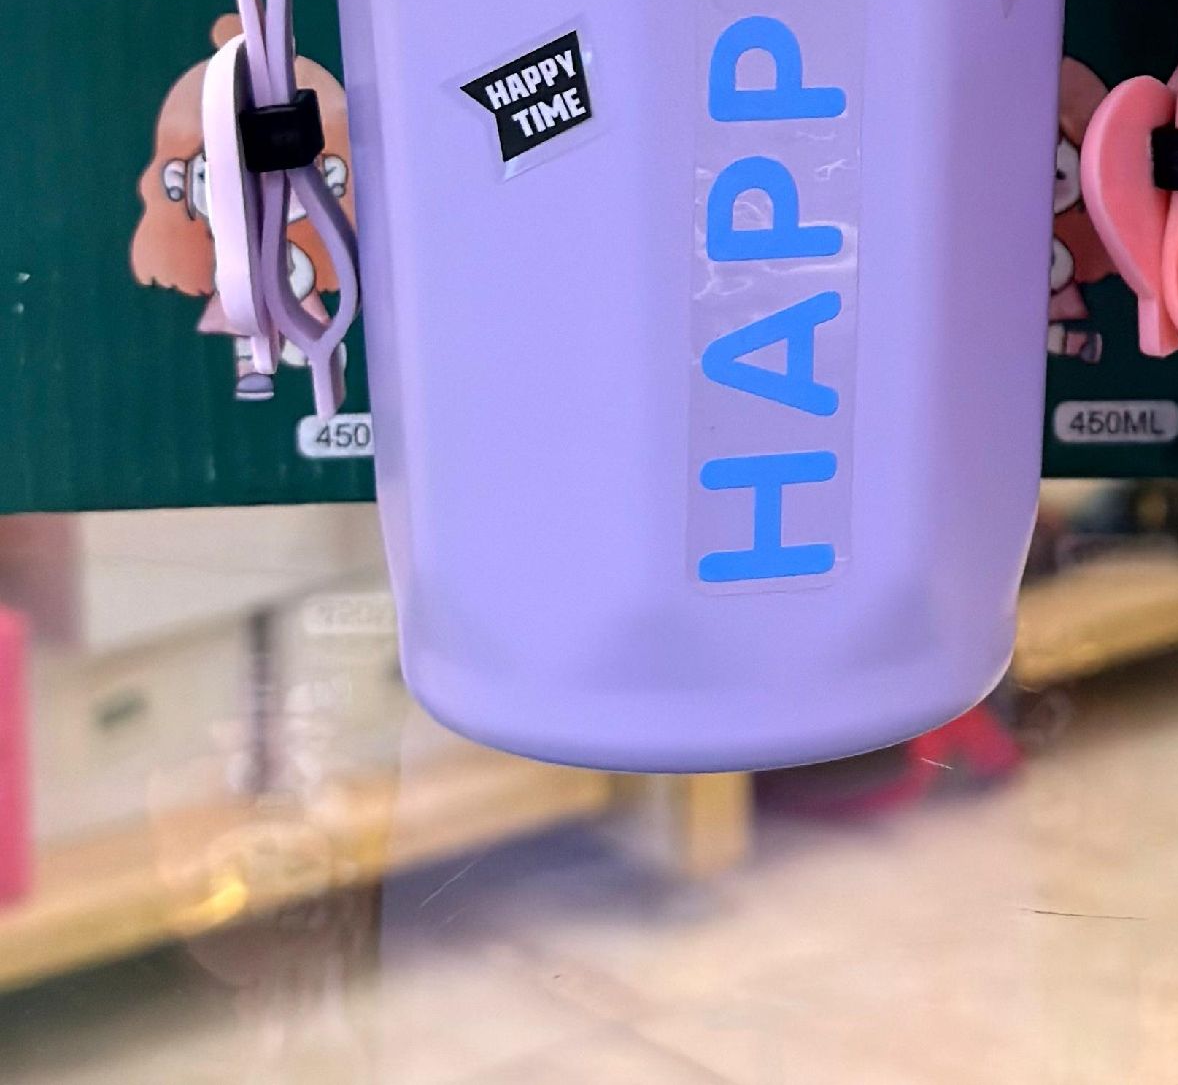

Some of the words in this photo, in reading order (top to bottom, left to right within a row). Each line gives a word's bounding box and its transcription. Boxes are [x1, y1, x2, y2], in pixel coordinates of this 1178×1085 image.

[484, 49, 577, 110] HAPPY
[511, 87, 587, 138] TIME
[1069, 411, 1165, 435] 450ML
